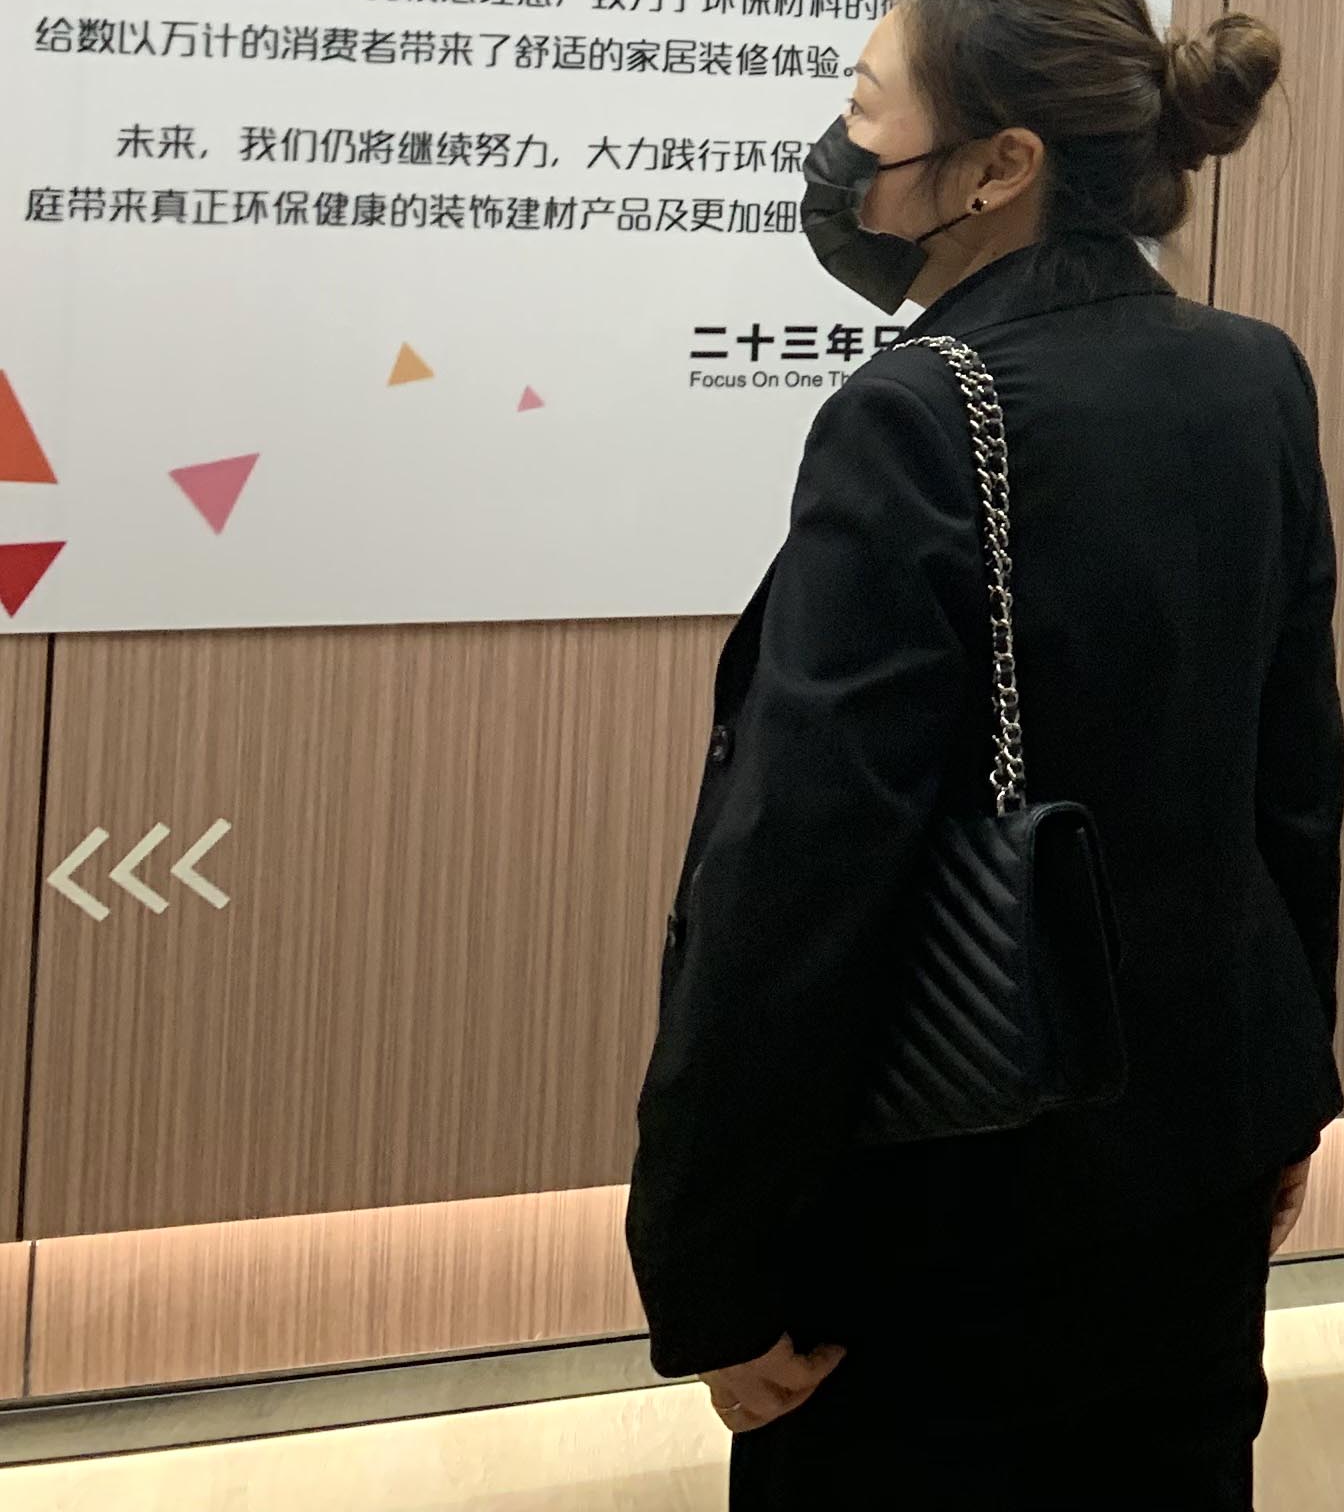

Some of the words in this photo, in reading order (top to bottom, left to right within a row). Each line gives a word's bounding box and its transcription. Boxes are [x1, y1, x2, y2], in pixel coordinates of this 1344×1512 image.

[116, 123, 814, 175] 未来，我们仍将继续努力，大力践行环保
[24, 186, 805, 235] 庭带来真正环保健康的装饰建材产品及更加细
[689, 370, 747, 389] Focus
[752, 370, 780, 389] On
[785, 370, 824, 389] One
